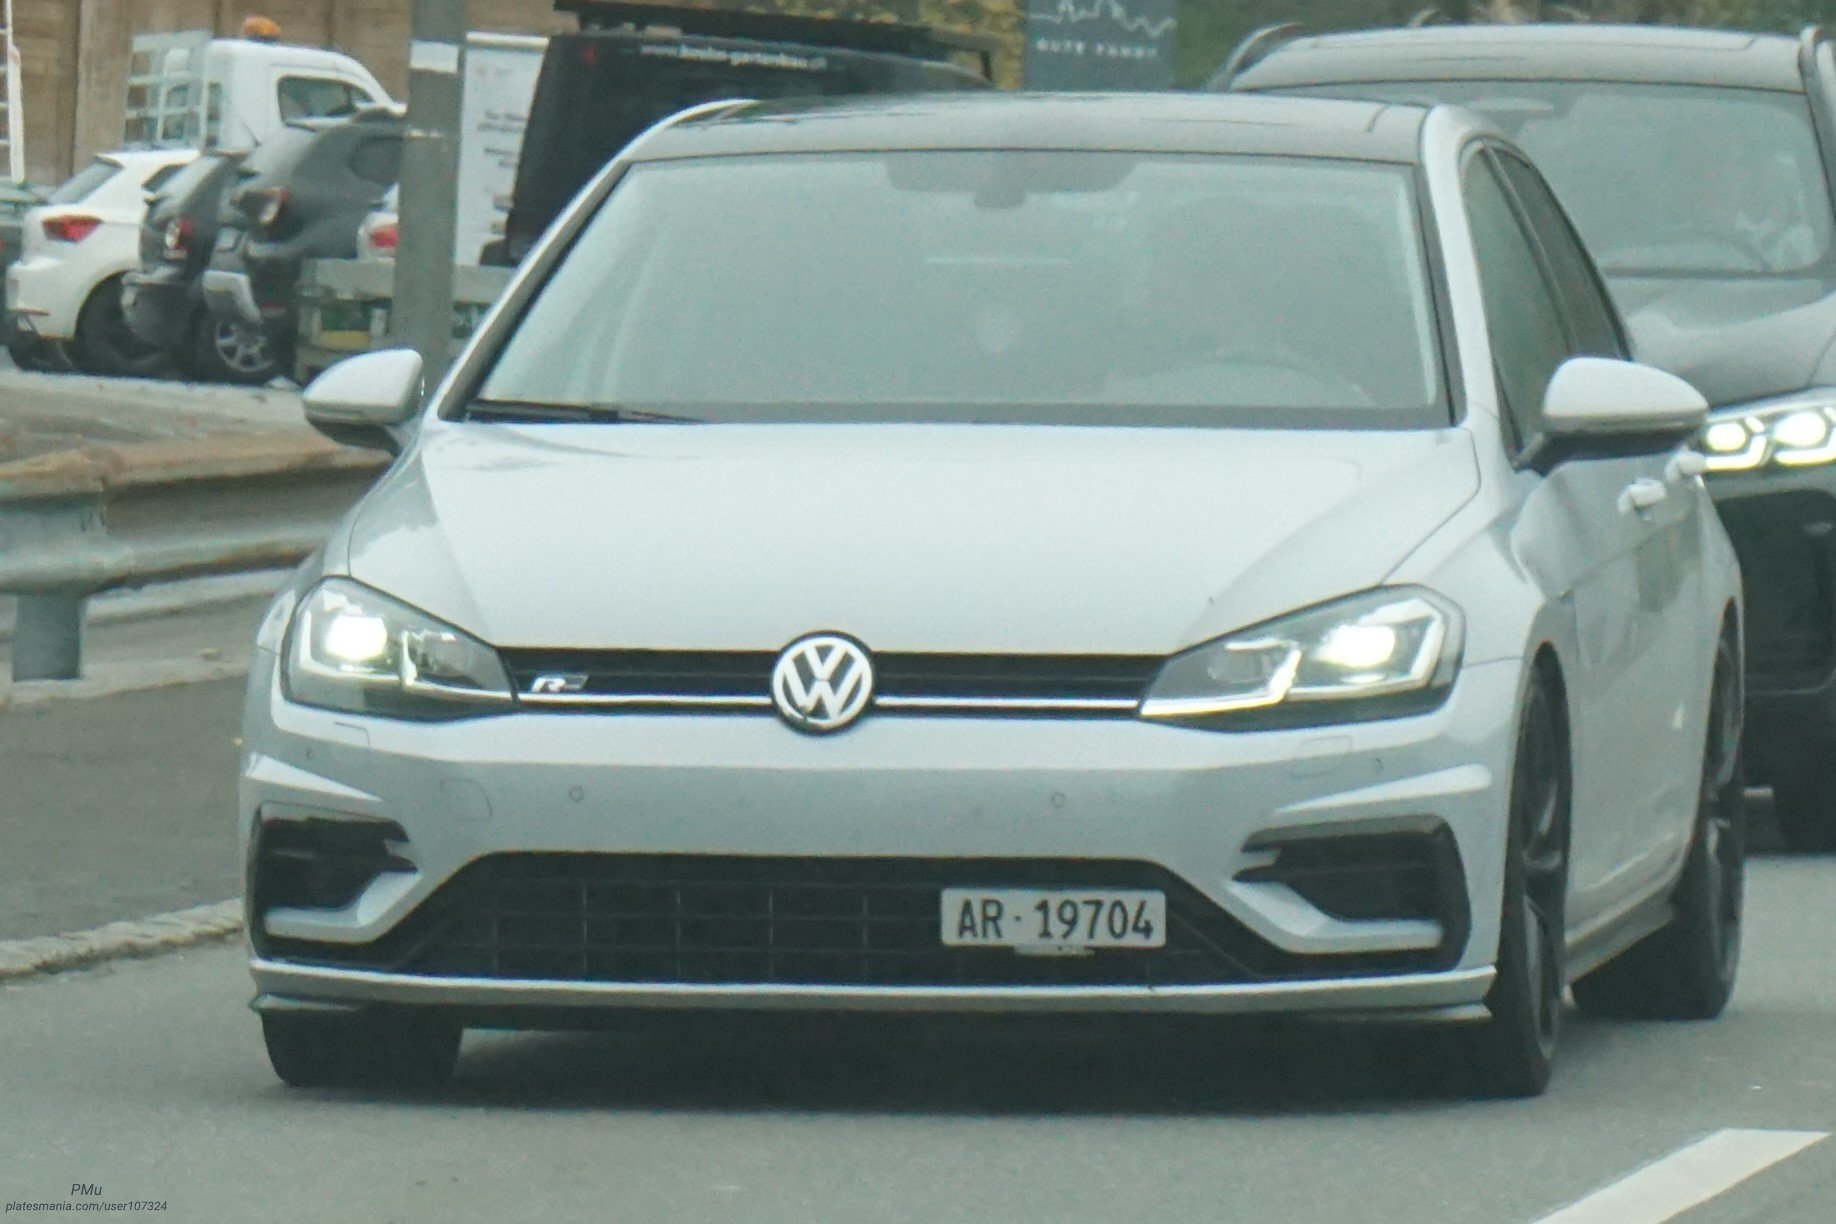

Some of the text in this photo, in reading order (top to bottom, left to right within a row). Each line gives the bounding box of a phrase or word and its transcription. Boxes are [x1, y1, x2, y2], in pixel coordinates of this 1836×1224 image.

[774, 637, 872, 728] VW
[958, 898, 1154, 940] AR 19704
